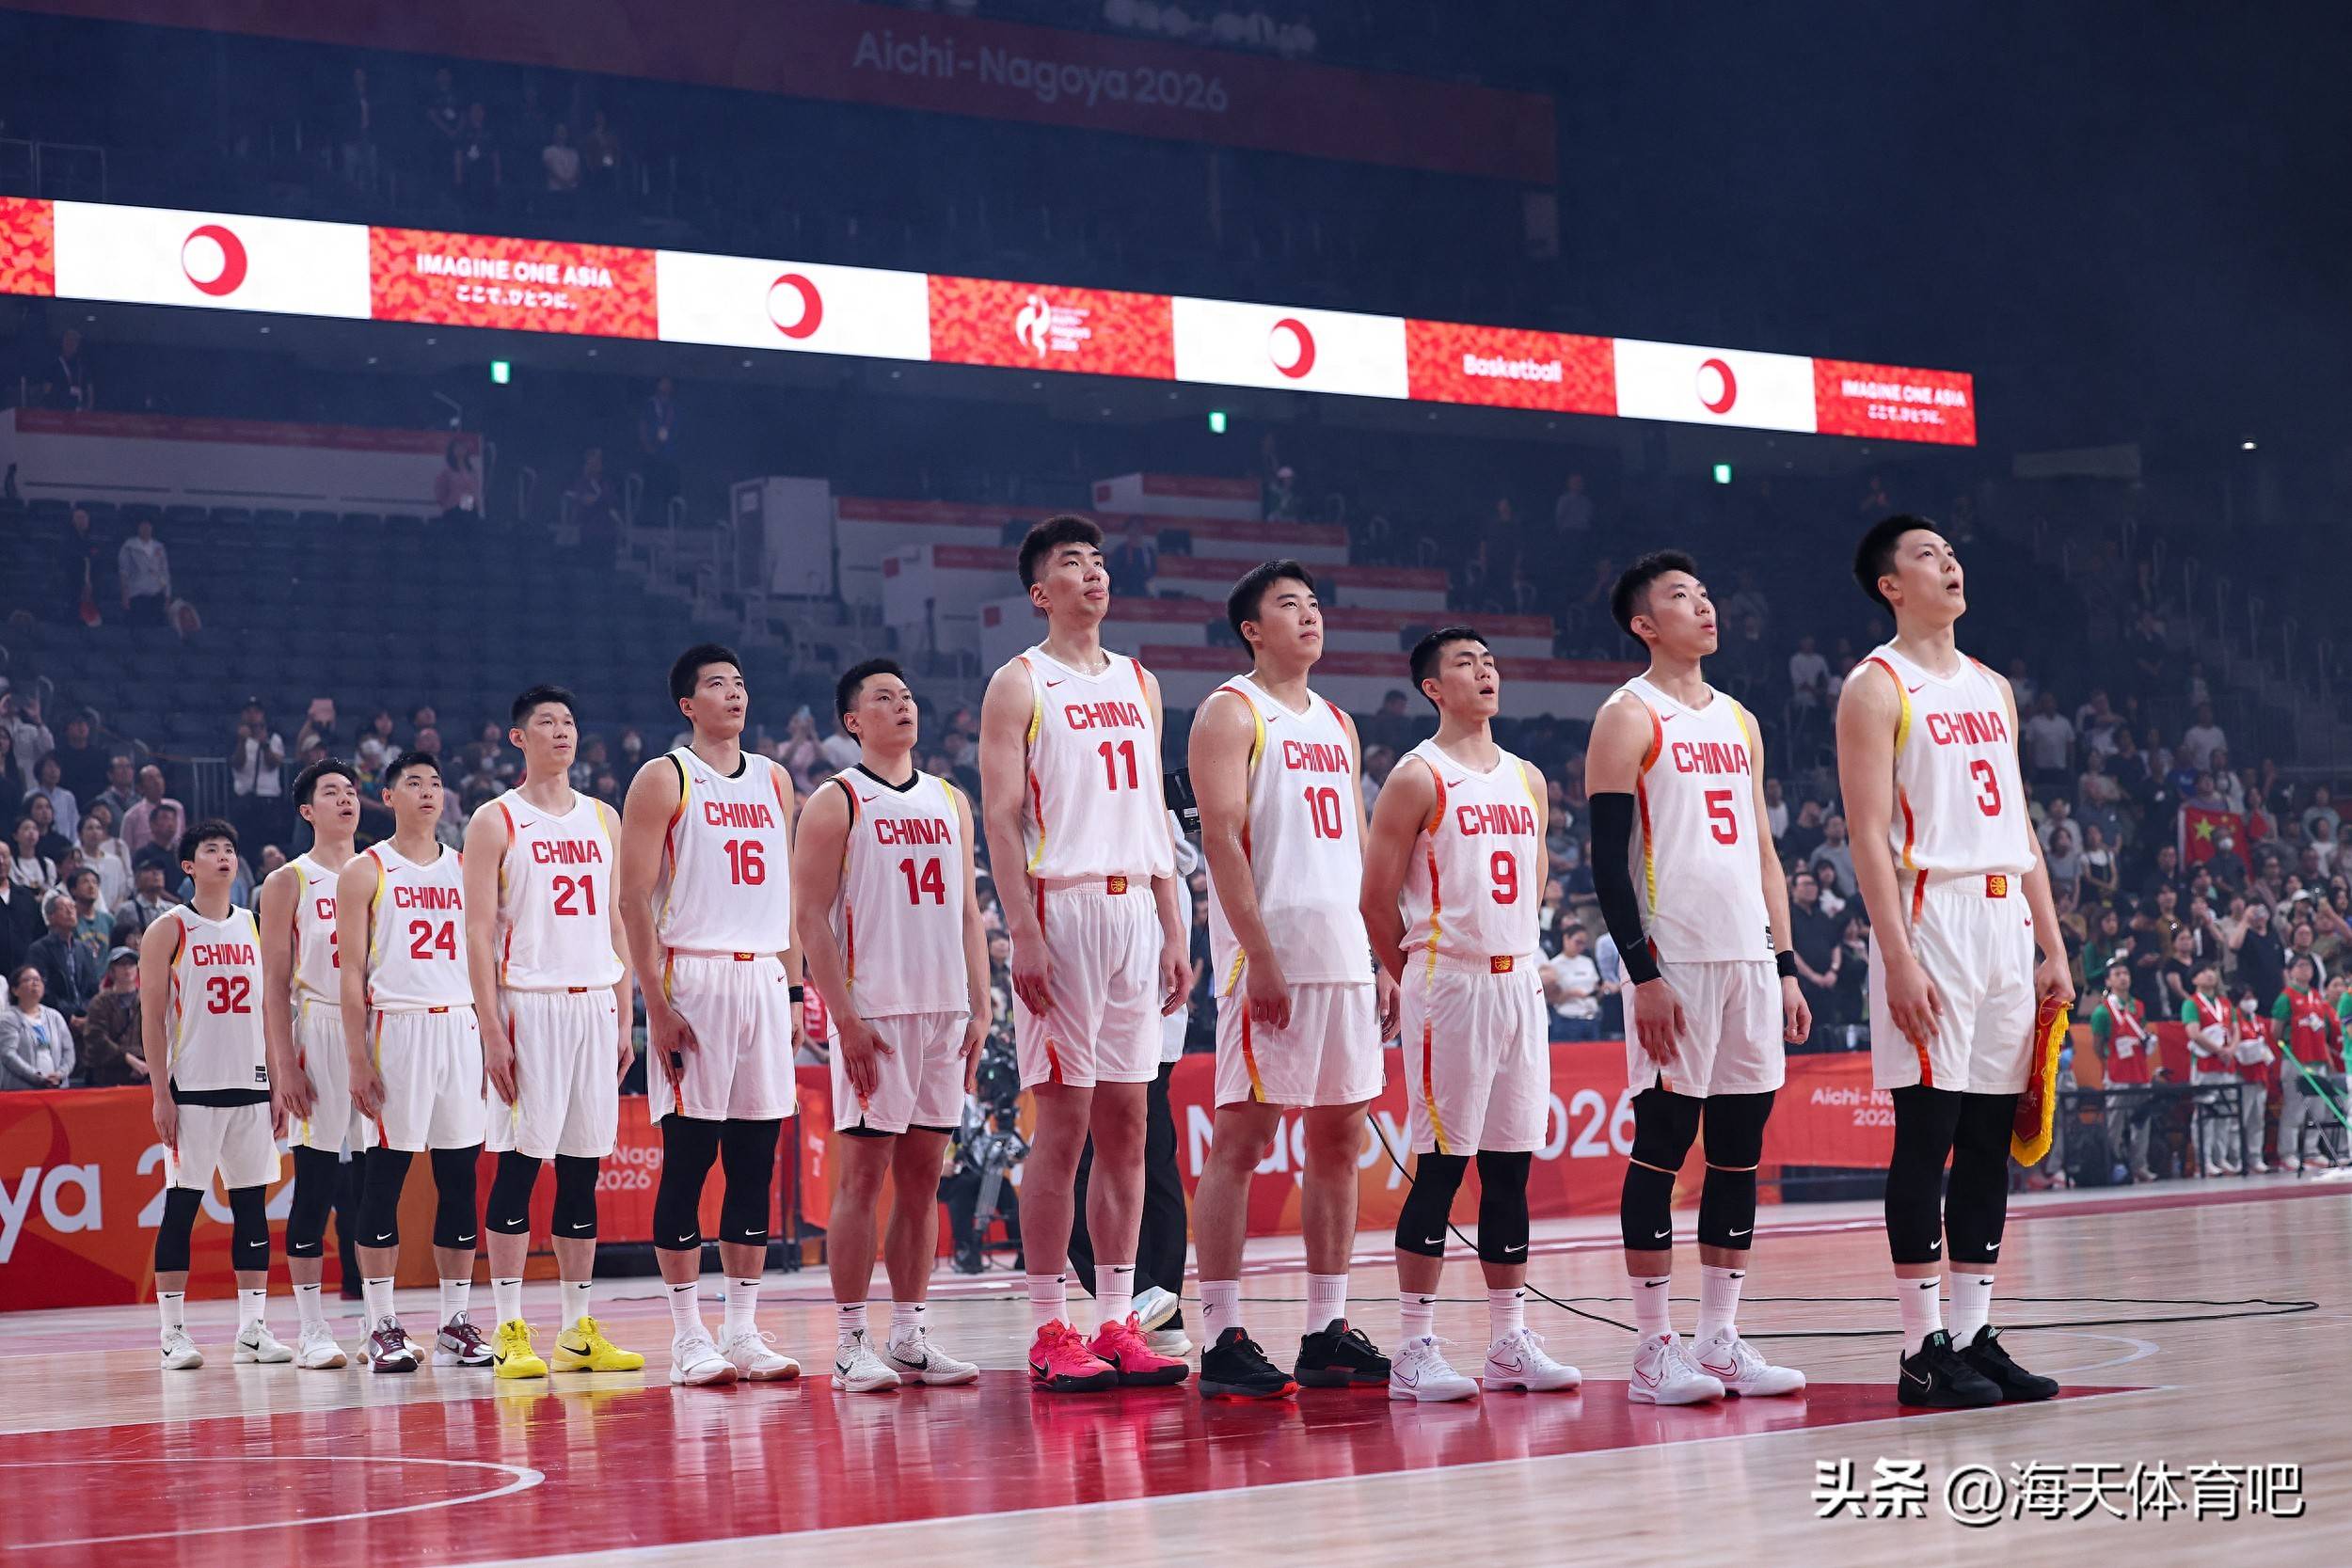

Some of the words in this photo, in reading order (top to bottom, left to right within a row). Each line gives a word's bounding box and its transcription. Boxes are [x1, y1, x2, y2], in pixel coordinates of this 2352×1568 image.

[852, 31, 1127, 105] Aichi-Nagoya
[1133, 67, 1229, 112] 2026
[416, 253, 510, 279] IMAGINE
[513, 261, 559, 284] ONE
[563, 265, 613, 288] ASIA
[1463, 354, 1563, 383] Basketball
[1064, 702, 1145, 730] CHINA
[1926, 711, 2007, 745] CHINA
[1098, 739, 1137, 790] 11
[1282, 740, 1350, 773] CHINA
[1672, 742, 1750, 775] CHINA
[1970, 759, 2001, 816] 3
[704, 800, 774, 828] CHINA
[1304, 786, 1343, 839] 10
[1456, 804, 1534, 836] CHINA
[1704, 790, 1738, 845] 5
[874, 818, 951, 845] CHINA
[532, 840, 602, 863] CHINA
[723, 839, 766, 885] 16
[898, 857, 945, 905] 14
[1490, 850, 1518, 904] 9
[393, 886, 463, 910] CHINA
[552, 875, 596, 915] 21
[192, 943, 255, 967] CHINA
[408, 920, 456, 960] 24
[206, 975, 251, 1014] 32
